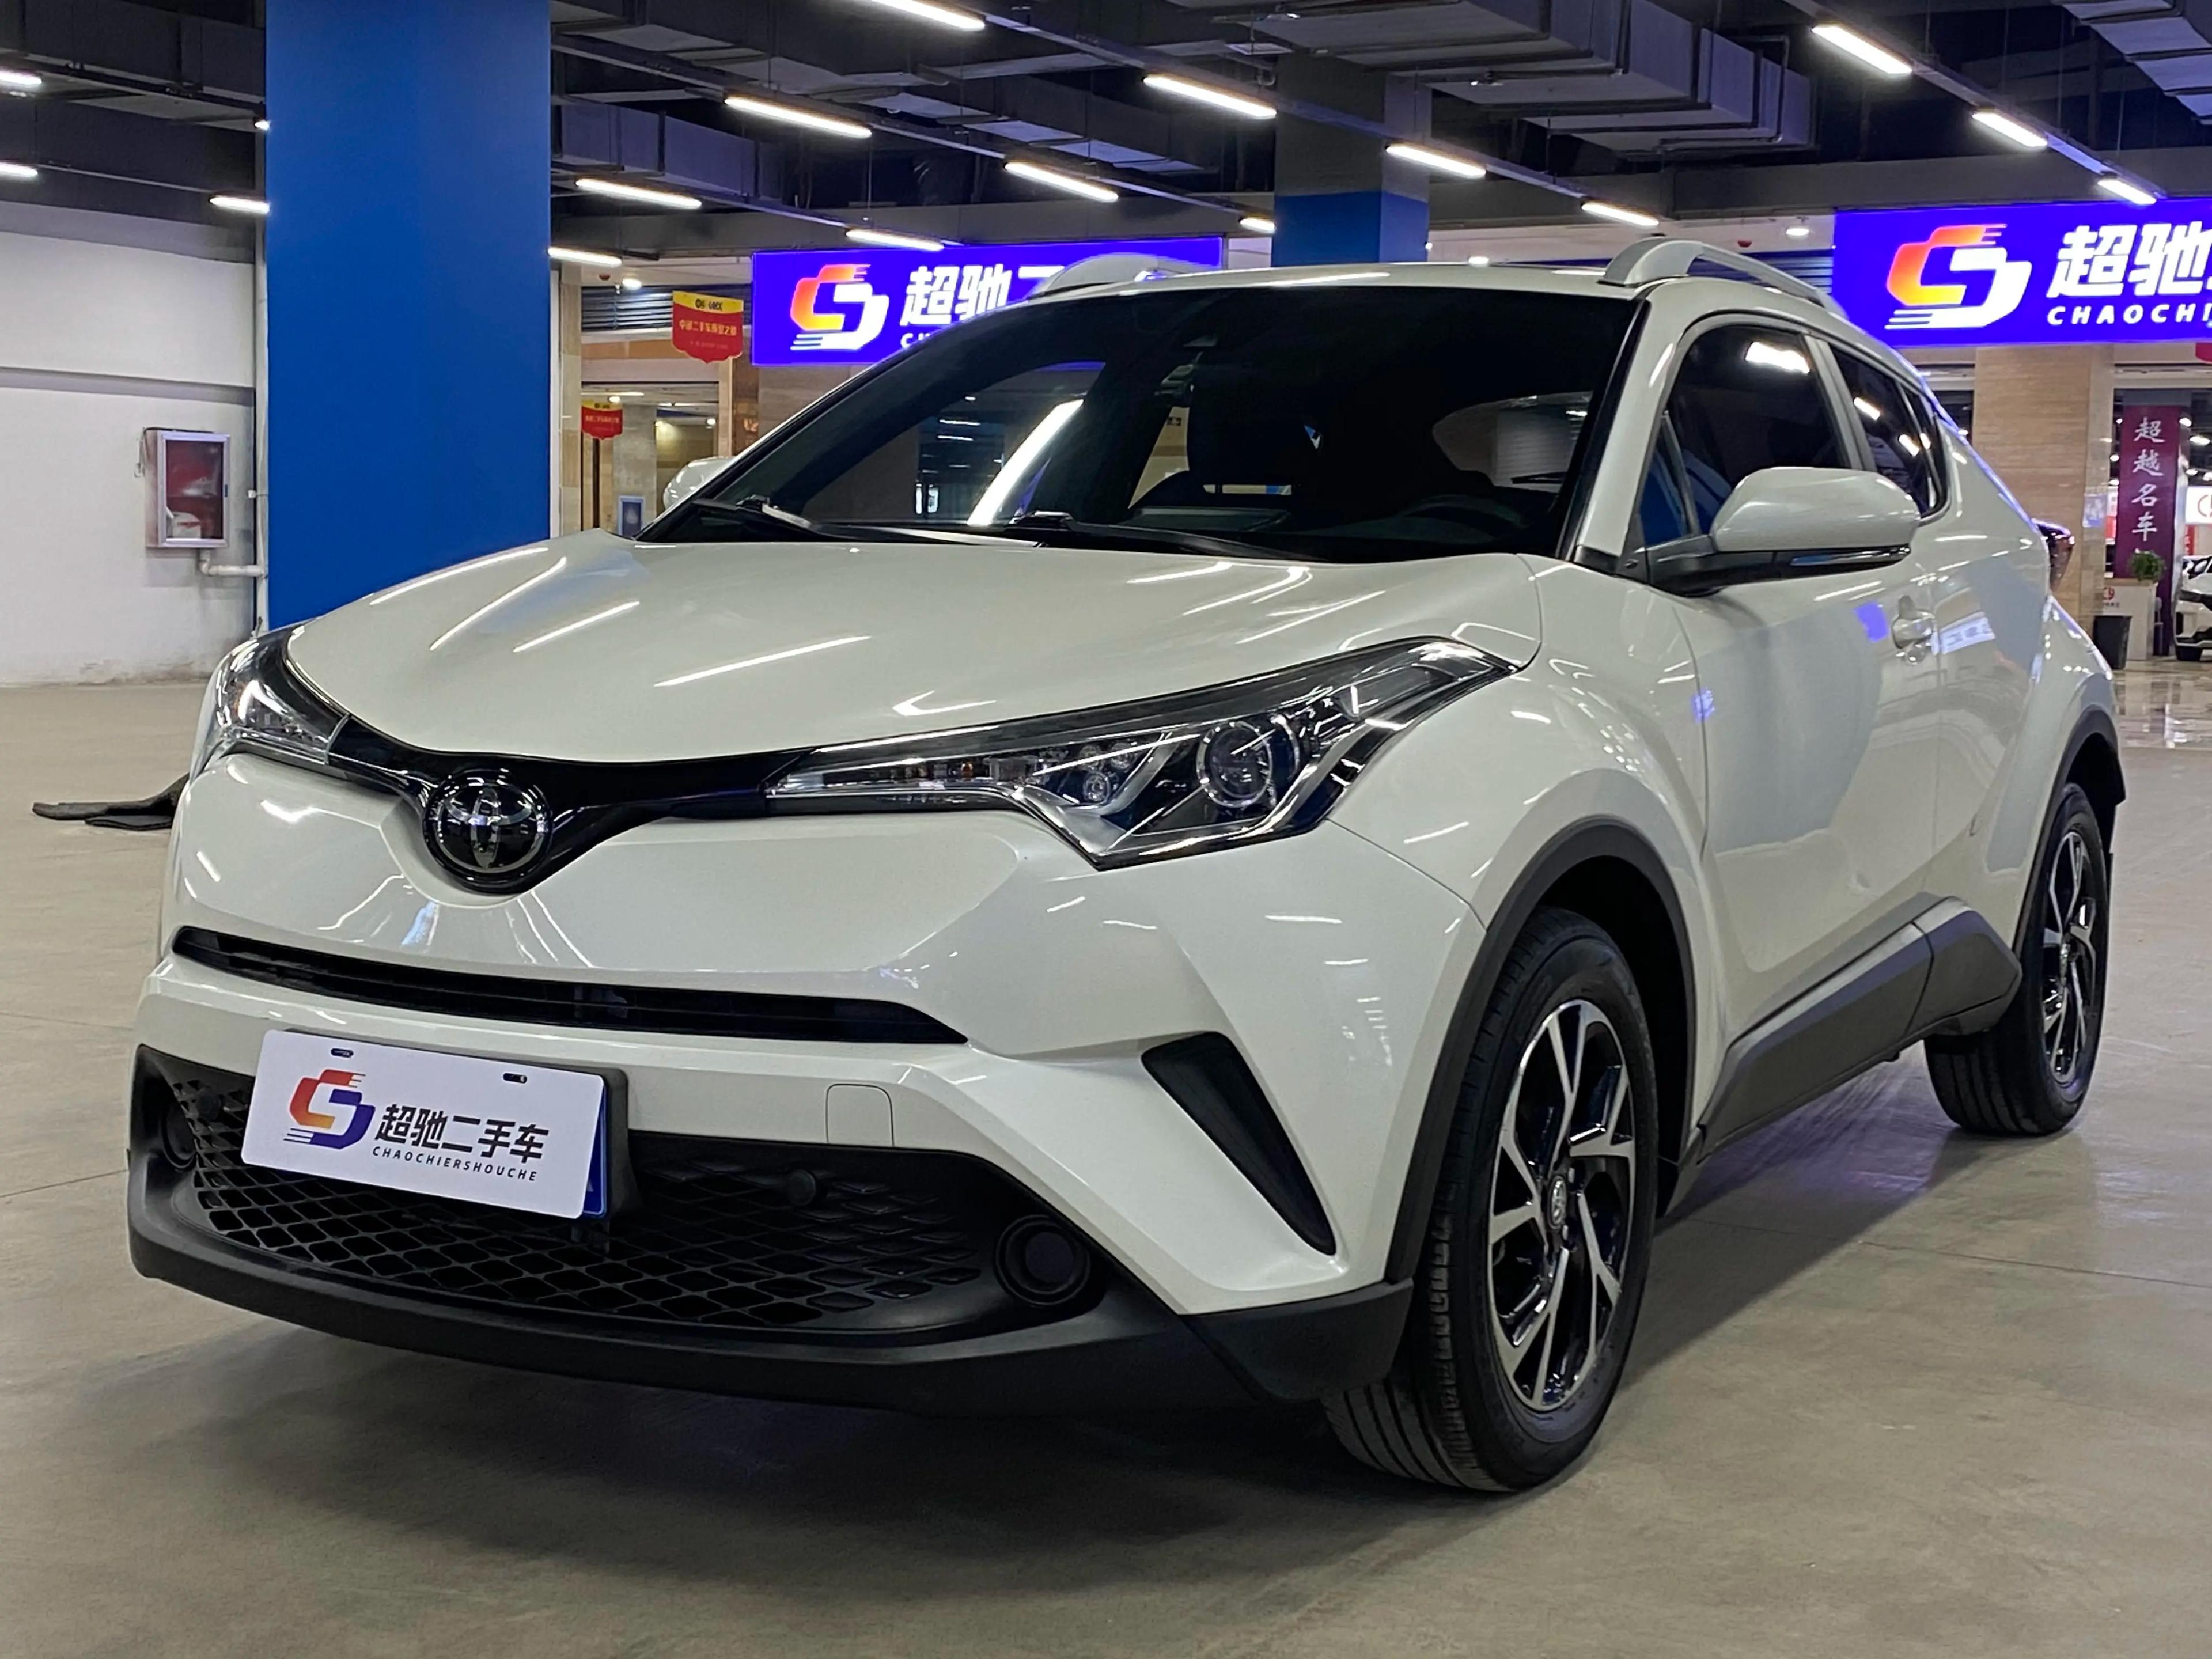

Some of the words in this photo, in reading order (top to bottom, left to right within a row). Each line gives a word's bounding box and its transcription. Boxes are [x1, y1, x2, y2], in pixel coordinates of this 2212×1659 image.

[2046, 221, 2212, 298] 超驰
[2131, 416, 2165, 541] 超越名车
[373, 1146, 537, 1181] CHAOCHIERSHOUCHE
[375, 1104, 549, 1164] 超驰二手车
